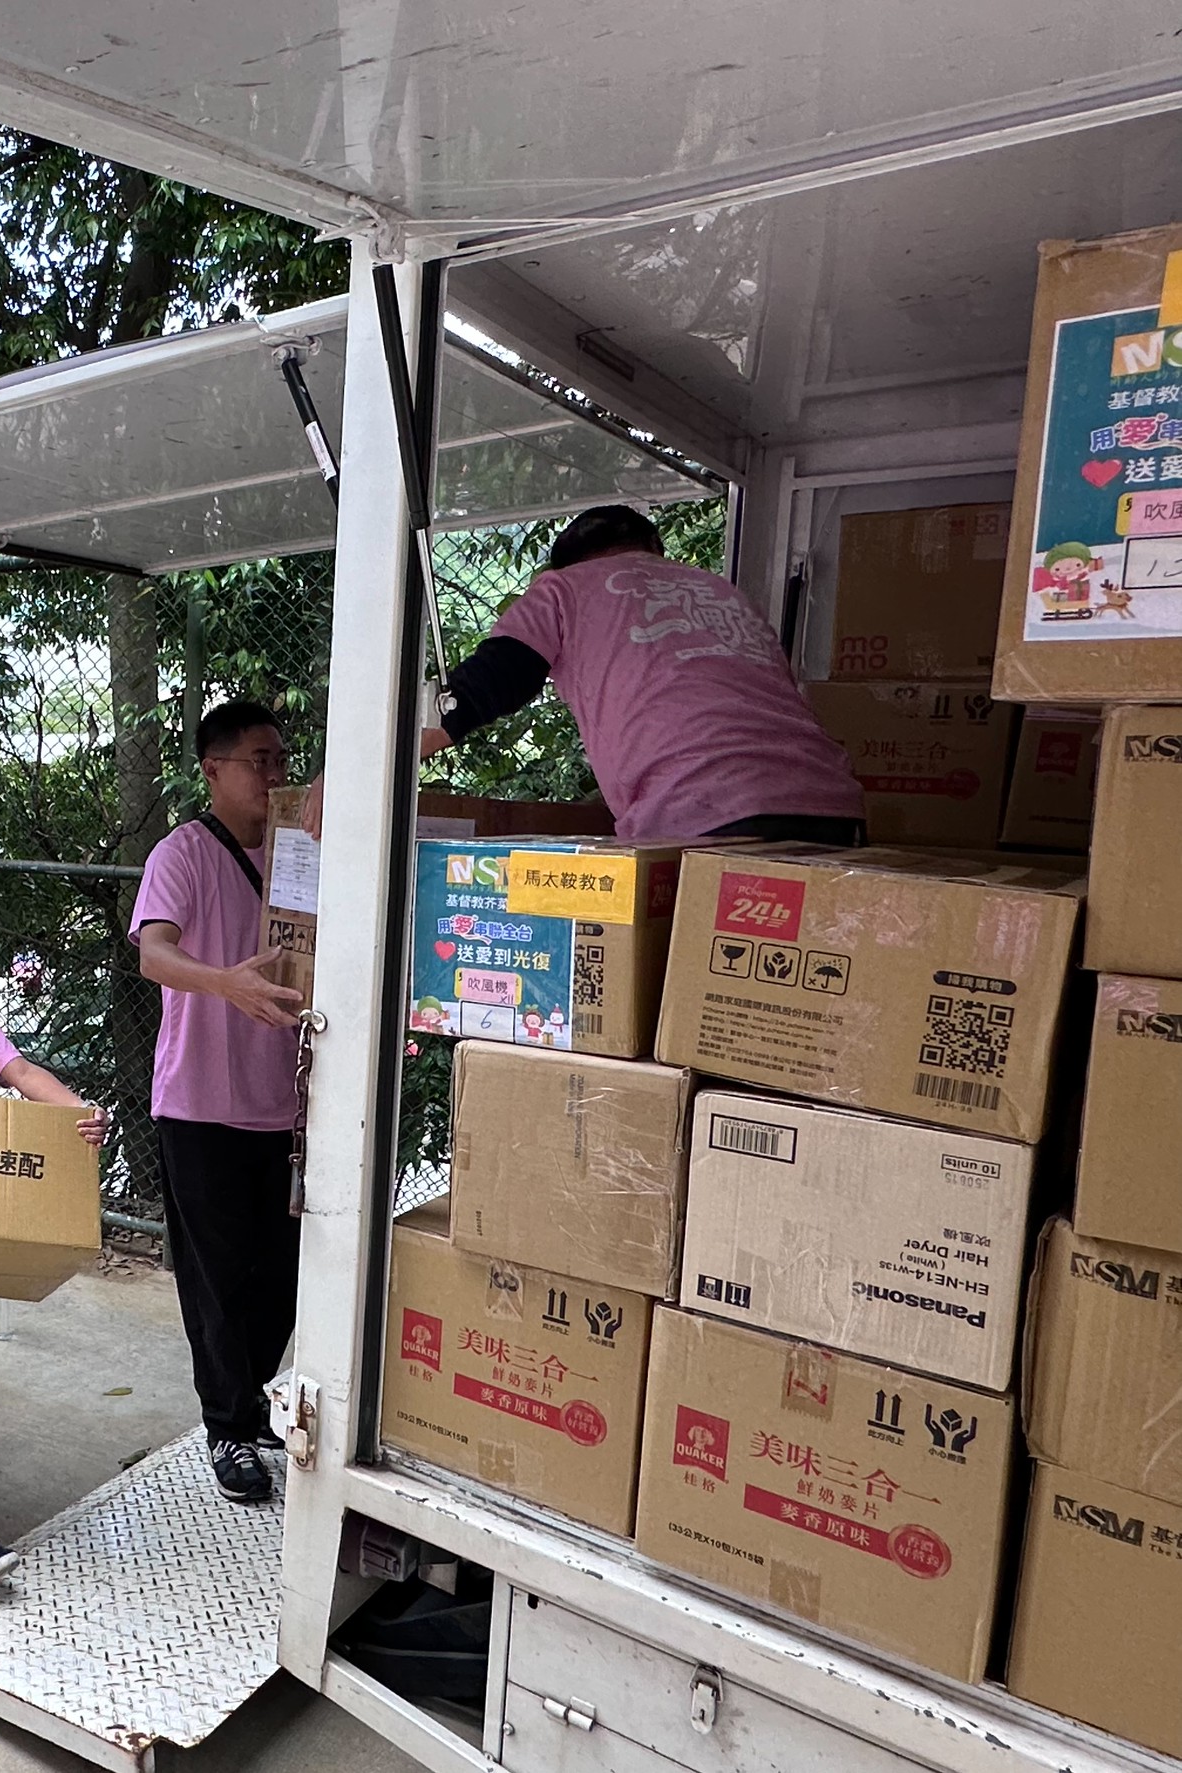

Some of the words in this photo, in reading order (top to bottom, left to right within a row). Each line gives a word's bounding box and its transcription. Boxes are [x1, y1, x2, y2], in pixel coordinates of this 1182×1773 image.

[524, 868, 615, 893] 馬太鞍教會
[726, 897, 791, 926] 24h
[438, 914, 534, 942] 用愛串聯全台
[457, 943, 551, 971] 送愛到光復
[467, 977, 508, 995] 吹風機
[480, 1009, 493, 1029] 6
[944, 1157, 978, 1172] units
[981, 1164, 998, 1175] 10
[904, 1238, 949, 1258] Dryer
[954, 1247, 989, 1267] Hair
[852, 1281, 986, 1329] Panasonic
[403, 1340, 439, 1361] QUAKER
[457, 1326, 599, 1384] 美味三合一
[492, 1366, 555, 1399] 鮮奶麥片
[480, 1386, 548, 1422] 麥香原味
[676, 1442, 725, 1470] QUAKER
[749, 1430, 942, 1505] 美味三合一
[683, 1470, 716, 1494] 桂格
[796, 1478, 880, 1520] 鮮奶麥片
[780, 1501, 871, 1547] 麥香原味
